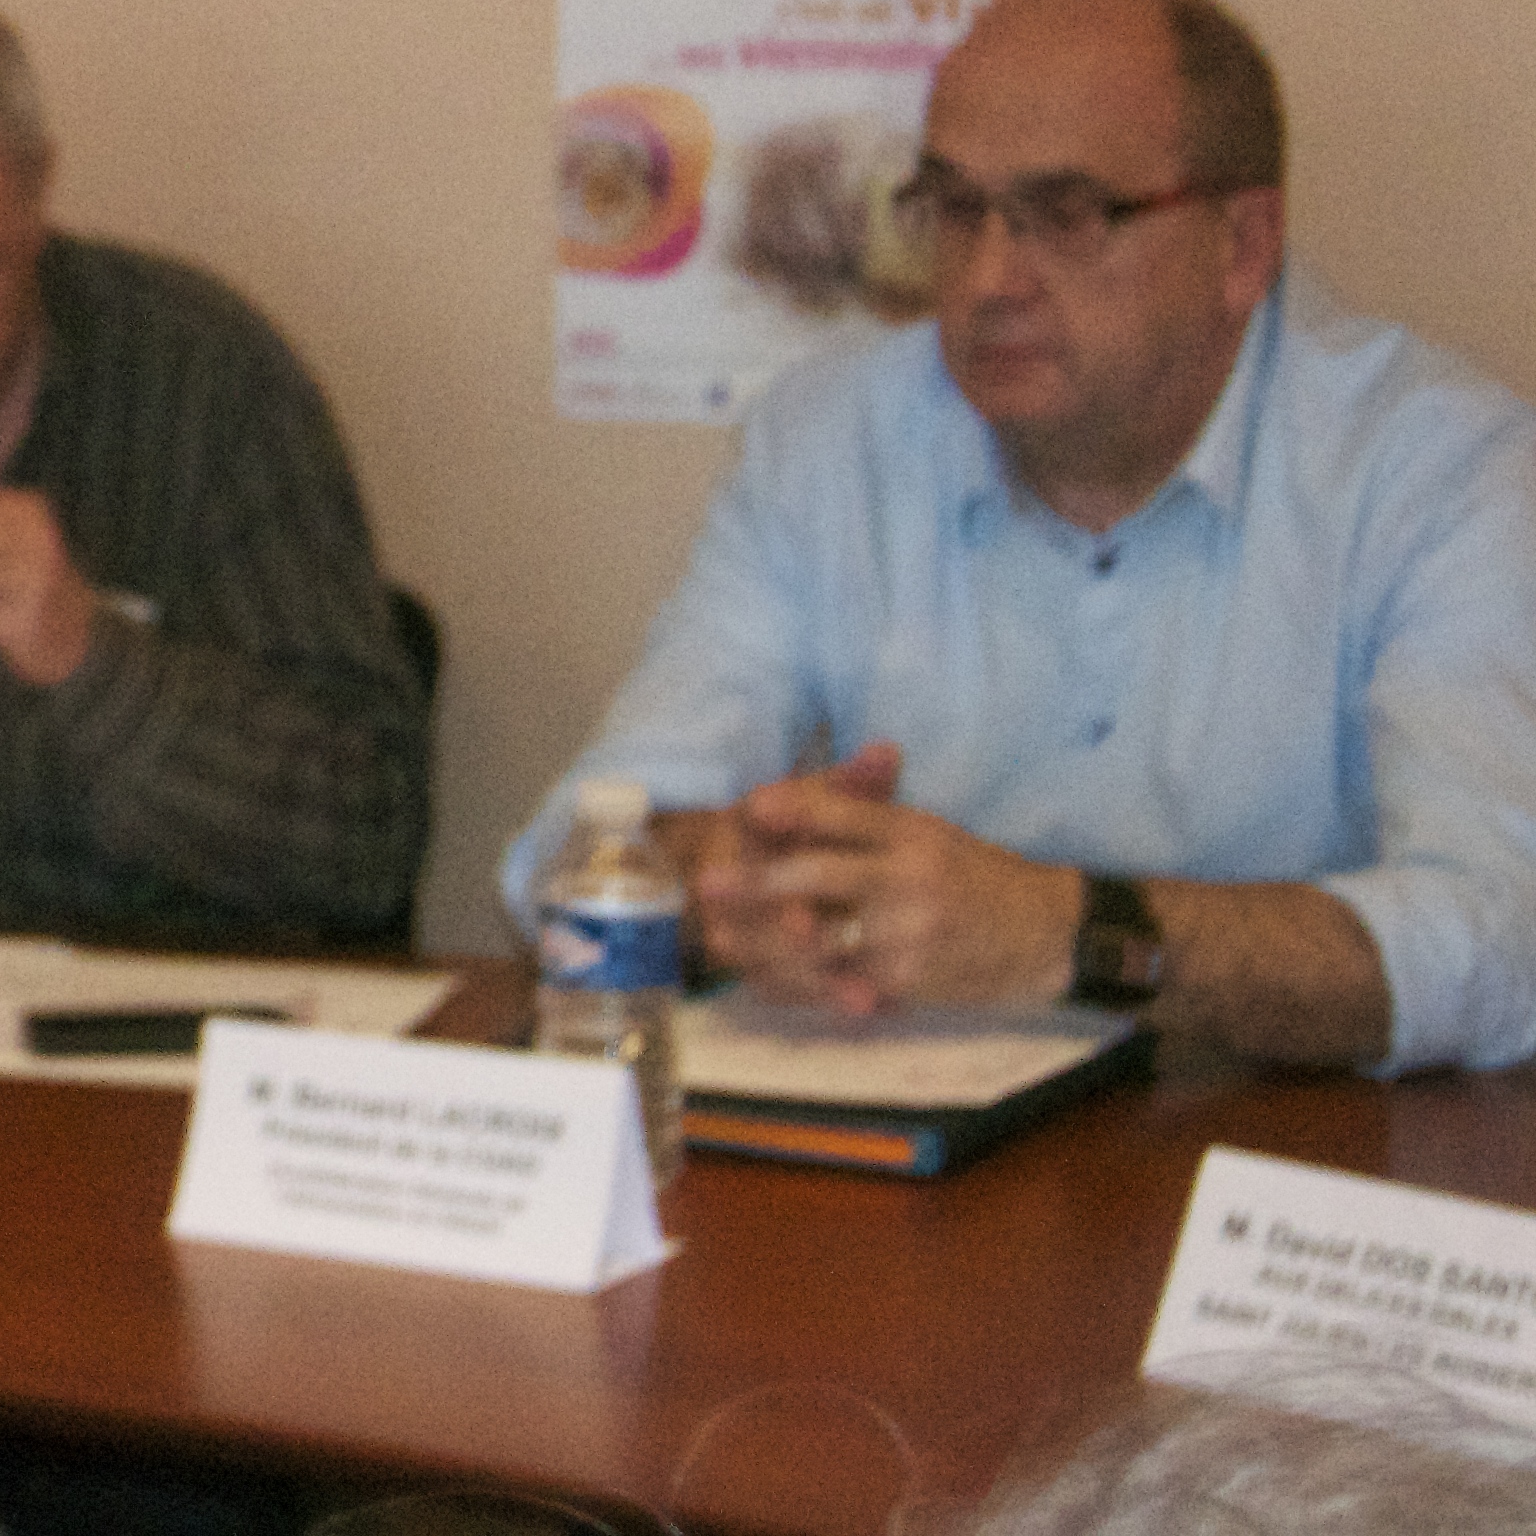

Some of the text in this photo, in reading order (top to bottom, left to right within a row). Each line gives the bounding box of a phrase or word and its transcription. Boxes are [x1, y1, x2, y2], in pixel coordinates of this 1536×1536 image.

[291, 1078, 411, 1122] Bernard
[1266, 1219, 1356, 1264] David
[1359, 1241, 1432, 1281] DOS
[1441, 1256, 1536, 1310] SANT
